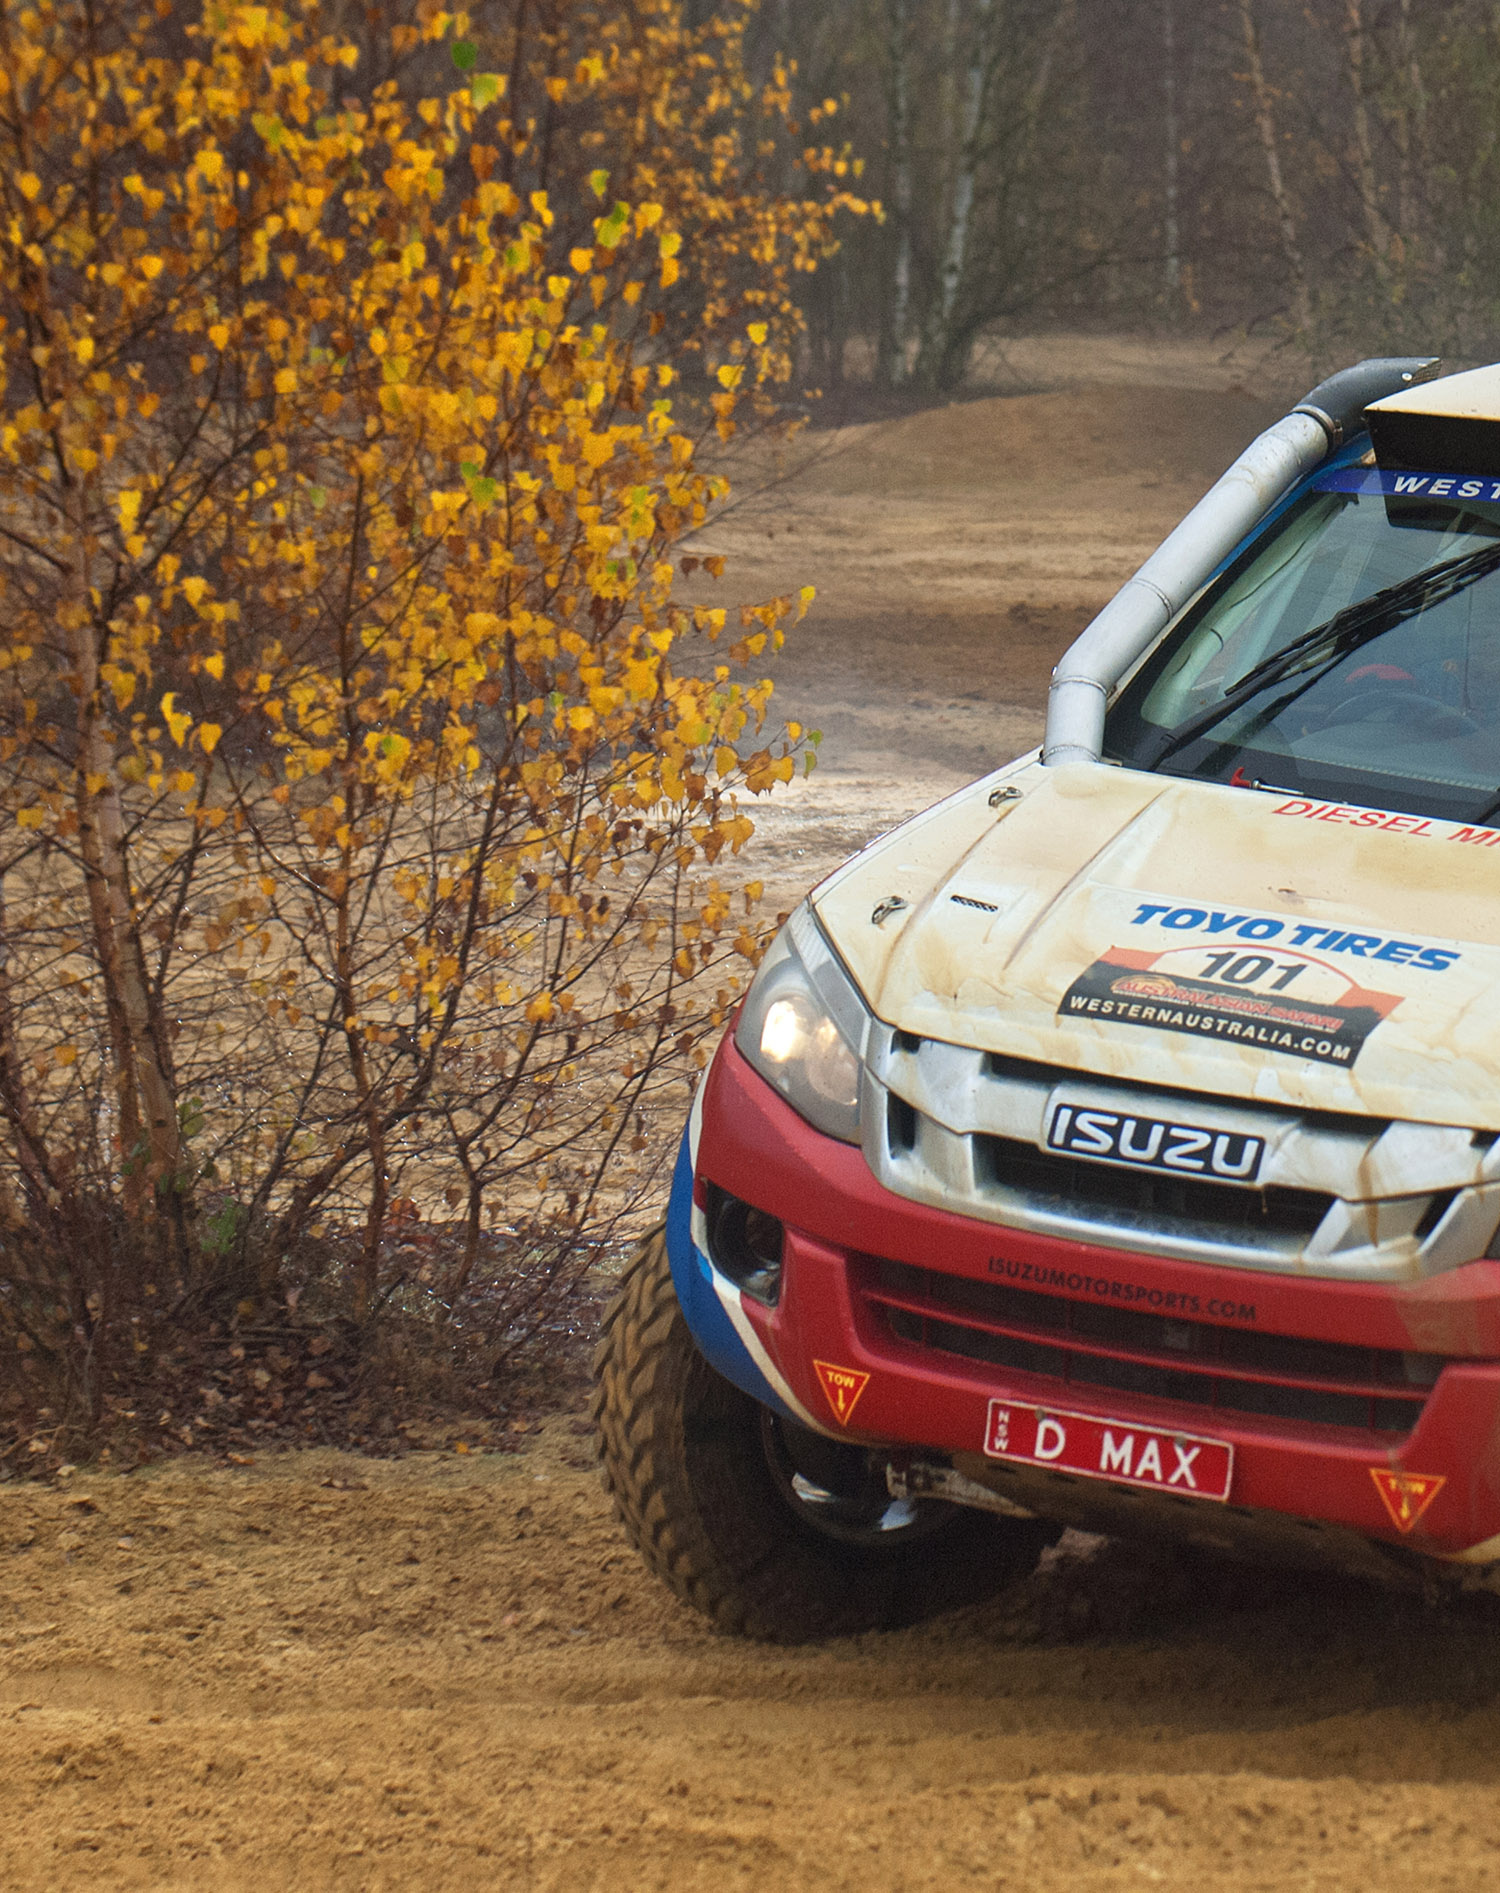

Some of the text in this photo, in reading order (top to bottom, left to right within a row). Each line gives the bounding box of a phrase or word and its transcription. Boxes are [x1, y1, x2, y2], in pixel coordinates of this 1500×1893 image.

[1272, 799, 1433, 838] DIESEL
[1130, 903, 1462, 972] TOYO TIRES
[1198, 950, 1308, 991] 101
[1069, 995, 1351, 1061] WESTERNAUSTRALIA.COM
[1051, 1105, 1262, 1178] ISUZU
[987, 1256, 1257, 1321] ISUZUMOTORSPORTS.COM
[826, 1370, 856, 1389] TOW
[993, 1410, 1010, 1452] NSW
[1034, 1418, 1201, 1489] D MAX
